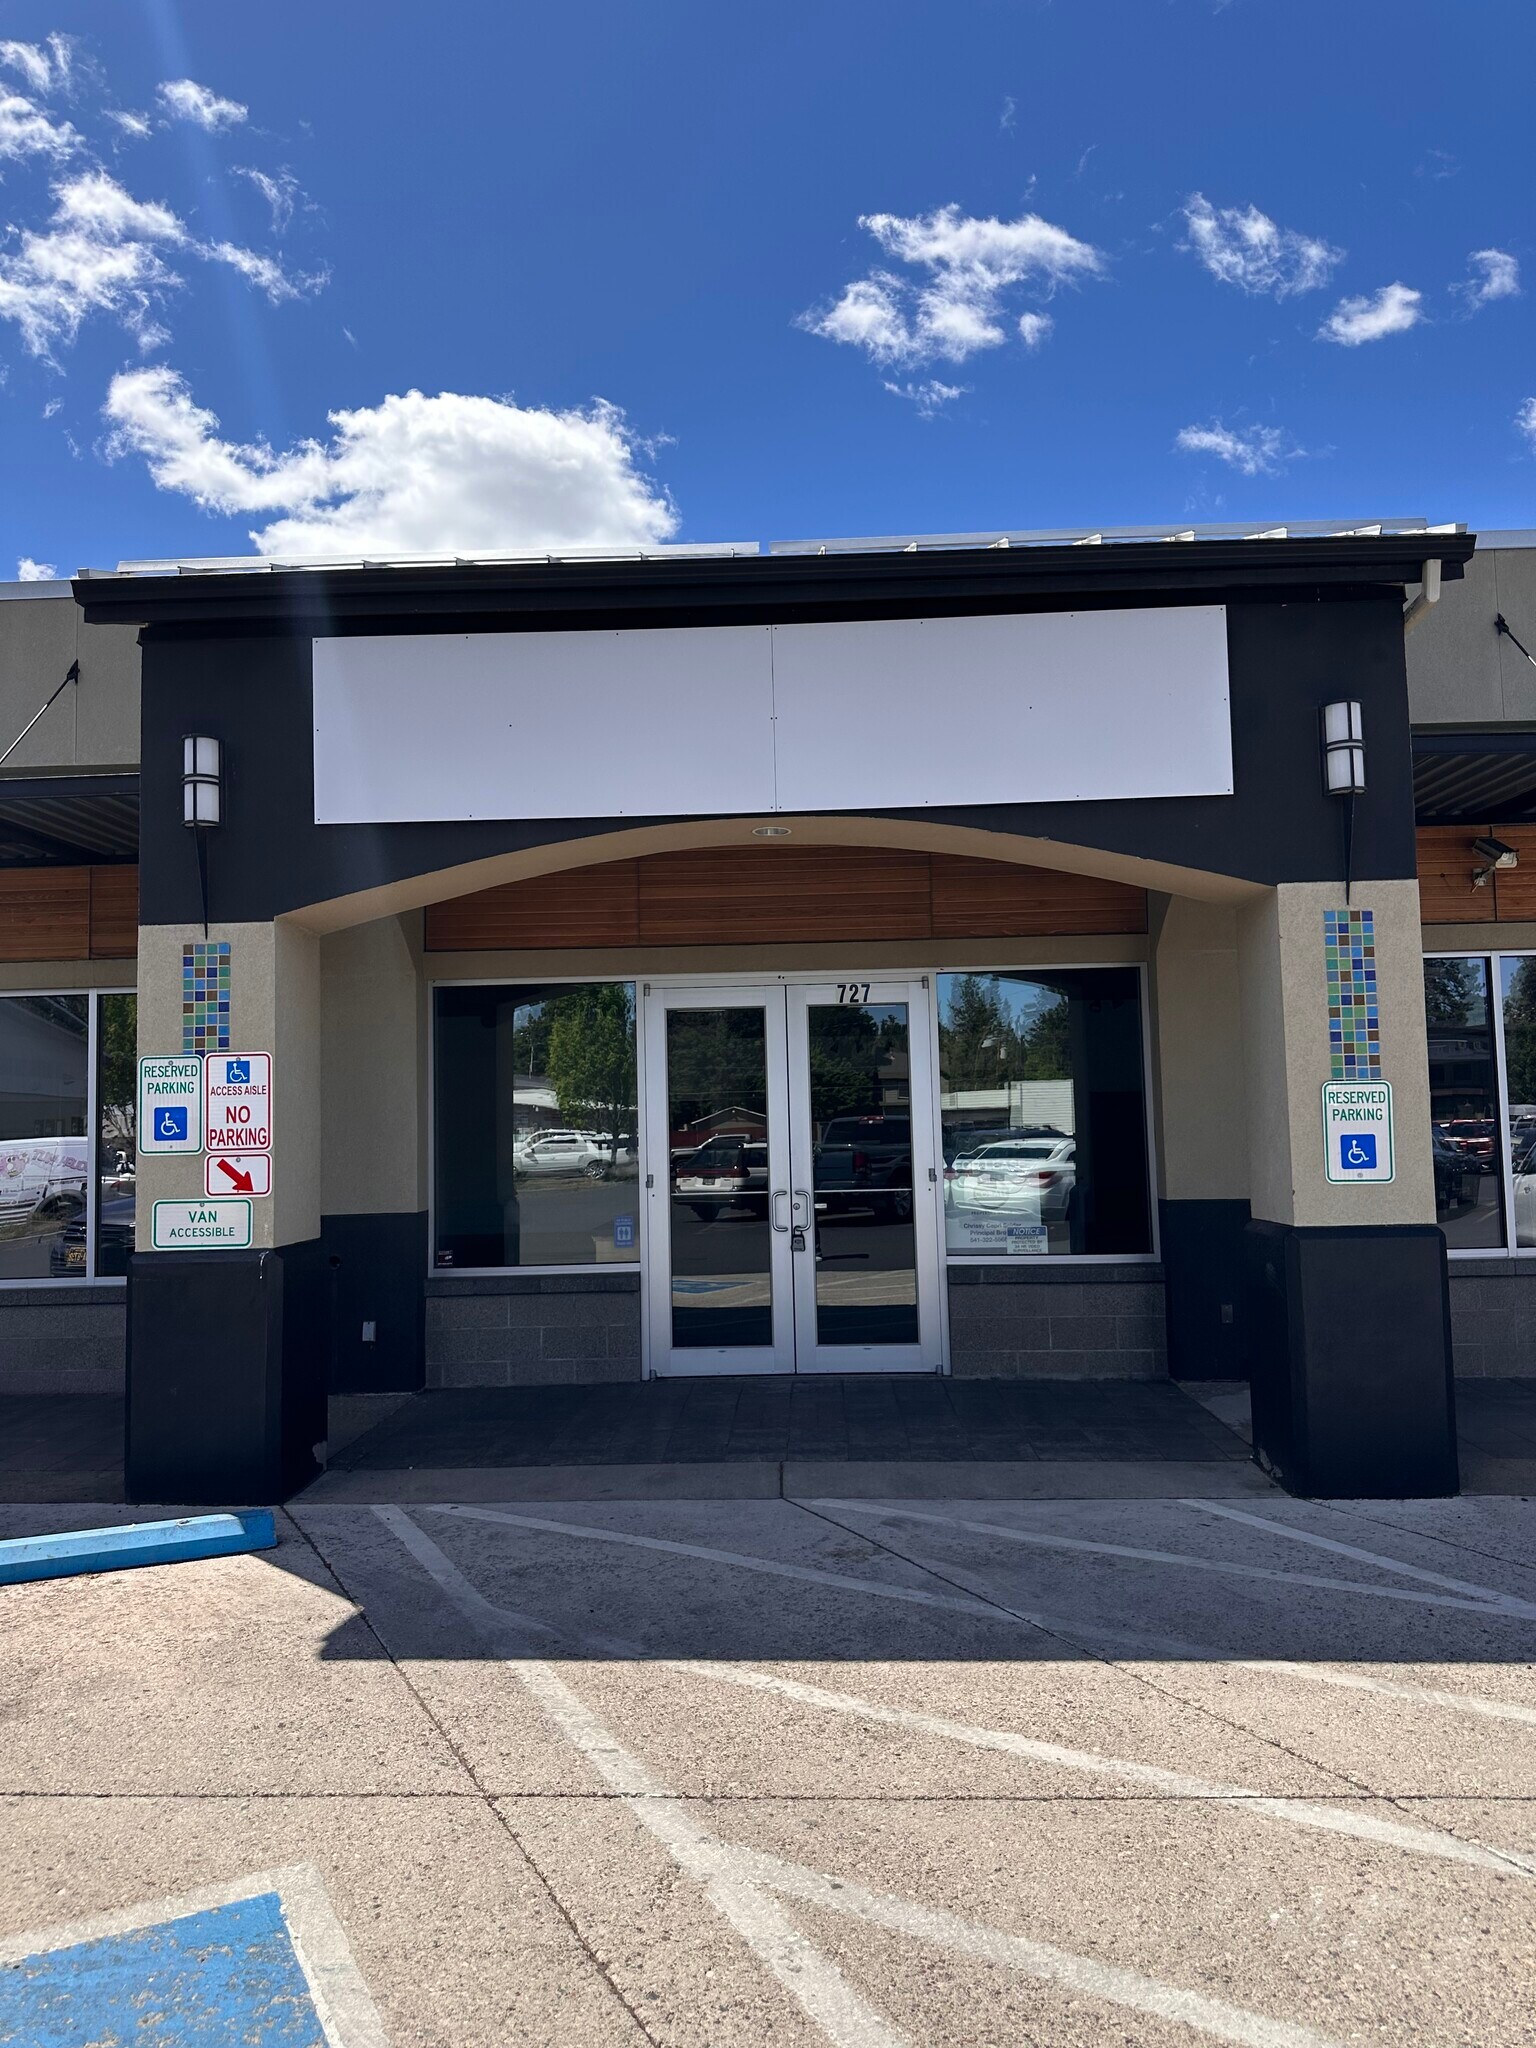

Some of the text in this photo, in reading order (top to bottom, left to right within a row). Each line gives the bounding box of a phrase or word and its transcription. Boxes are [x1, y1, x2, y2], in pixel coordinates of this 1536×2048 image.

[837, 984, 870, 1003] 727
[144, 1065, 198, 1078] RESERVED
[147, 1081, 195, 1094] PARKING
[210, 1085, 267, 1096] ACCESS AISLE
[1328, 1090, 1386, 1104] RESERVED
[226, 1105, 251, 1124] NO
[1332, 1108, 1383, 1121] PARKING
[209, 1127, 267, 1147] PARKING
[188, 1210, 217, 1223] VAN
[169, 1226, 235, 1238] ACCESSIBLE
[1012, 1227, 1040, 1235] NOTICE
